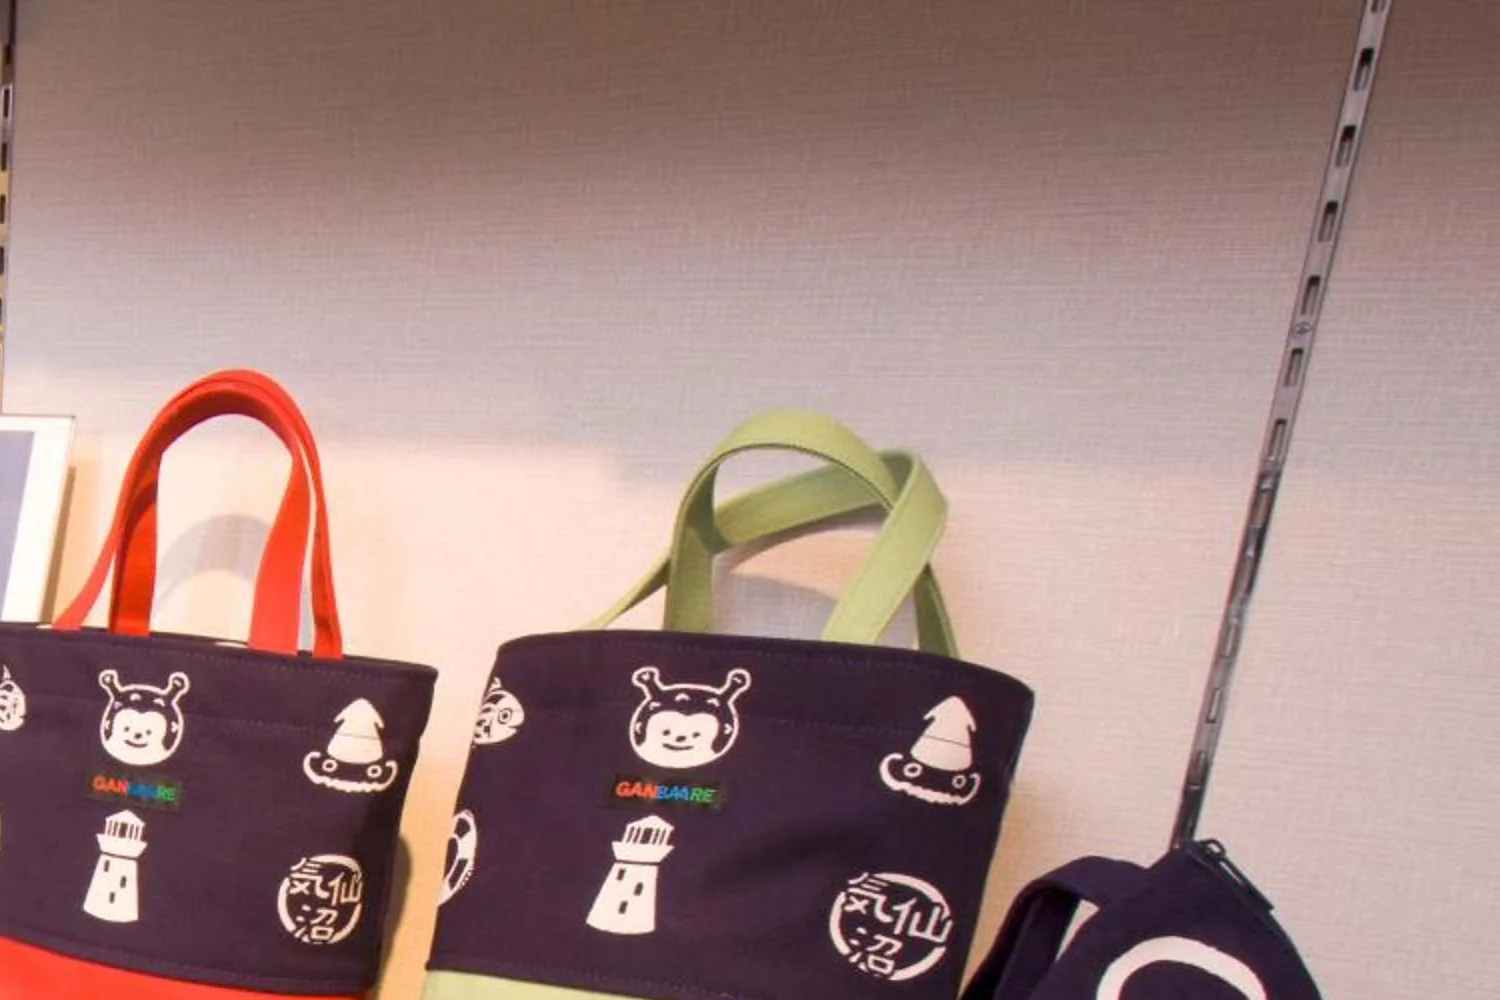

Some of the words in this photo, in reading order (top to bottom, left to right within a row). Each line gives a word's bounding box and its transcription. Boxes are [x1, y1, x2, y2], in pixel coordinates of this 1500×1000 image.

[289, 857, 363, 944] 気仙沼
[844, 872, 953, 977] 気仙沼
